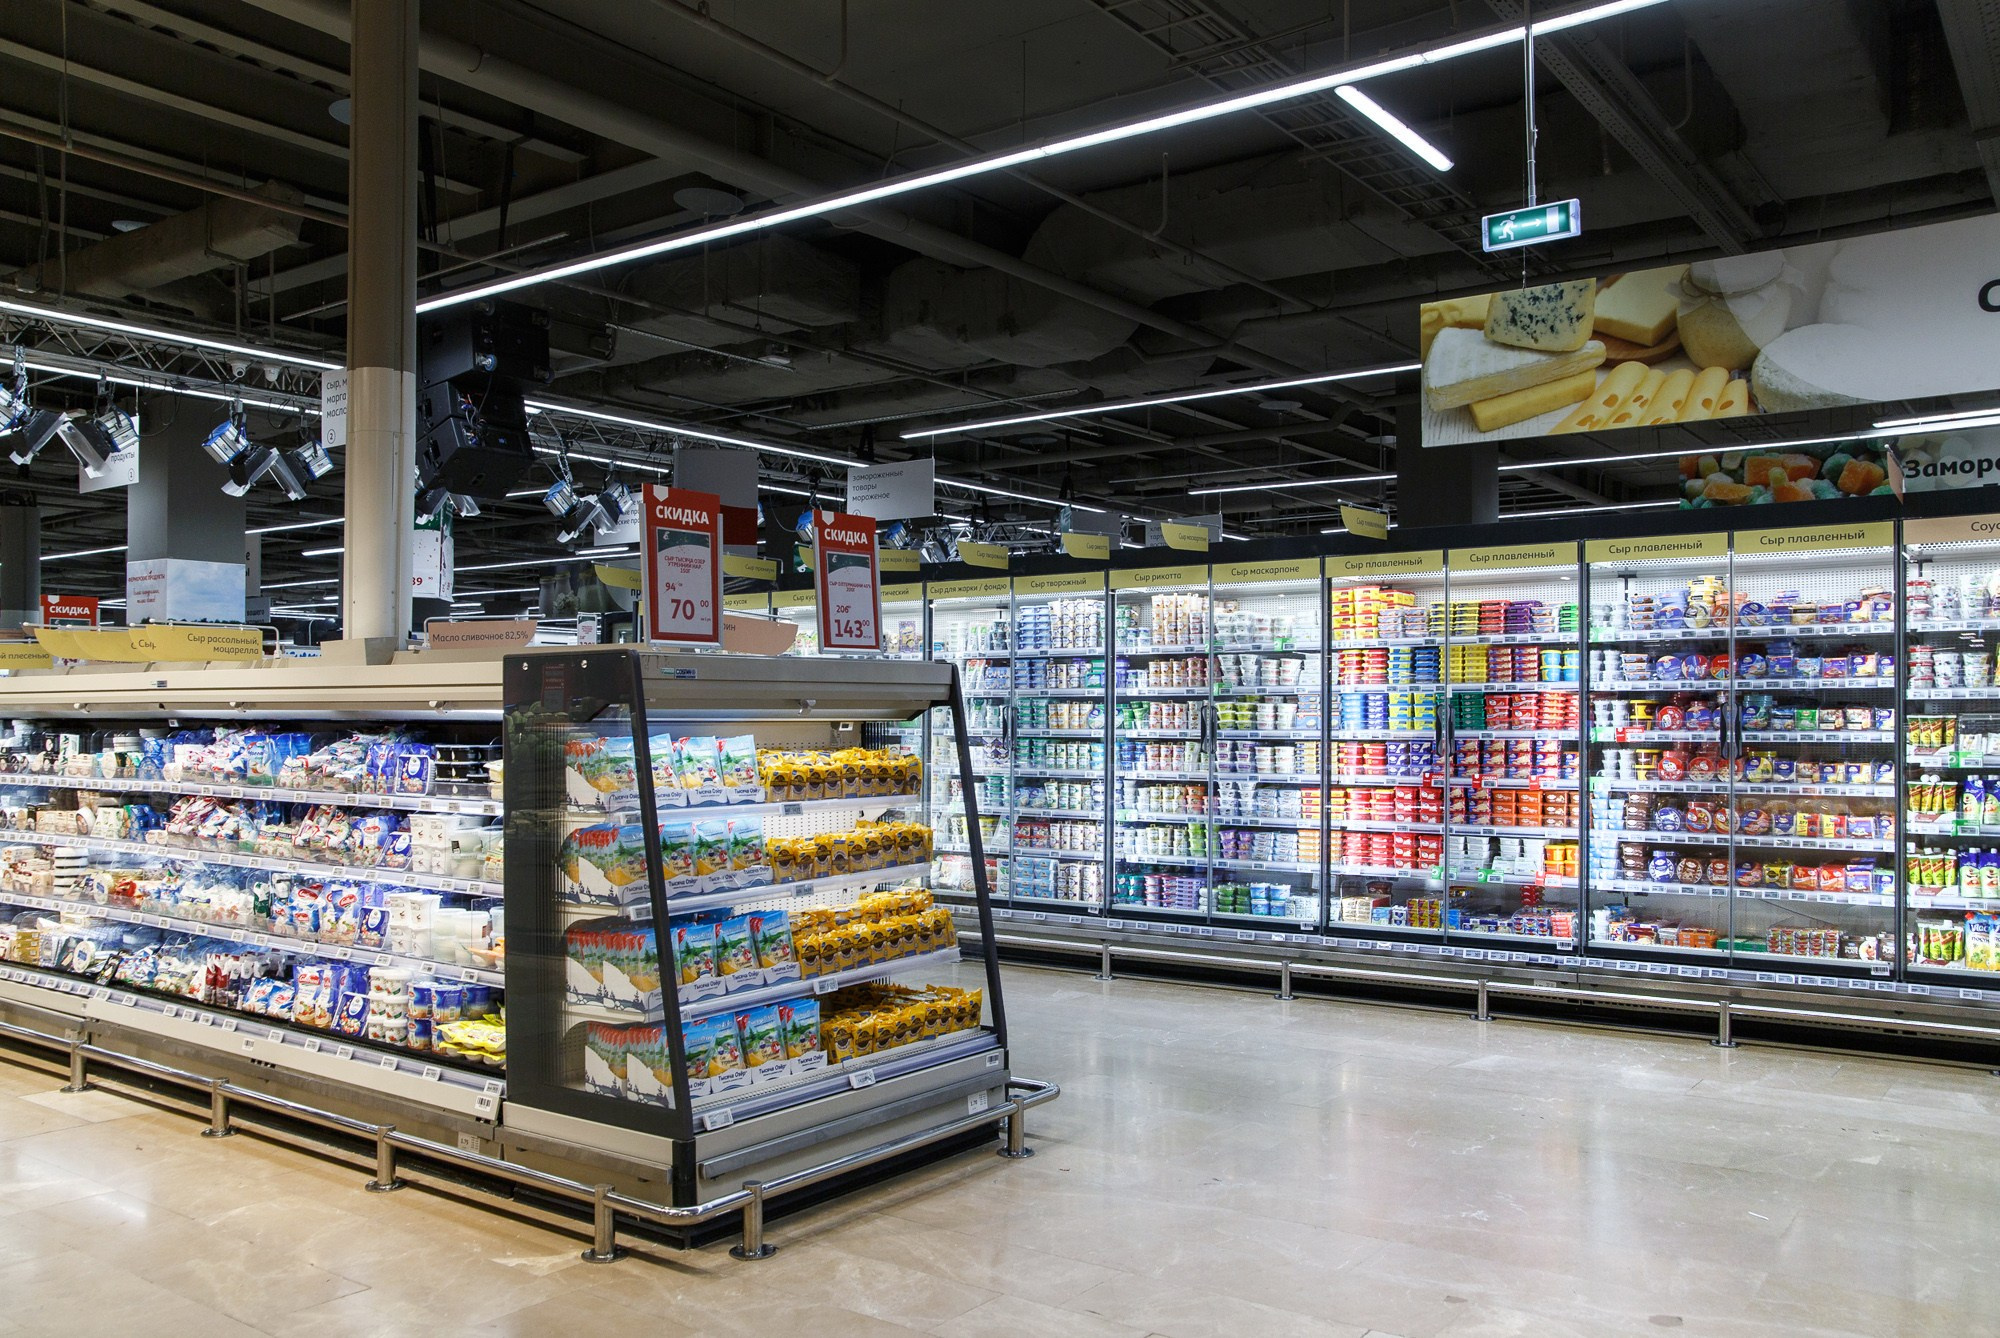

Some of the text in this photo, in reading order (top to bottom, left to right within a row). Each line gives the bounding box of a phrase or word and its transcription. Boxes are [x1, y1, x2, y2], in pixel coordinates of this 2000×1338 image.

[852, 470, 904, 482] замороженные
[852, 484, 877, 492] товары
[852, 493, 890, 503] мороженое
[655, 505, 710, 526] СКИДКА
[824, 528, 868, 546] СКИДКА
[1760, 529, 1865, 547] Сыр плавленный
[1608, 540, 1703, 555] Сыр плавленный
[1469, 549, 1555, 564] Сыр плавленный
[1231, 564, 1299, 577] Сыр маскарпоне
[1344, 556, 1423, 572] Сыр плавленный
[1030, 577, 1087, 589] Сыр творожный
[1134, 572, 1182, 583] Сыр рикотта
[665, 582, 676, 592] 94
[930, 582, 1007, 595] Сыр для жарки / фондю
[49, 605, 90, 616] СКИДКА
[670, 598, 709, 621] 70 00
[834, 619, 863, 639] 143
[187, 633, 259, 647] Сыр рассольный,
[432, 631, 529, 642] Масло сливочное 82,5%
[8, 652, 50, 660] плесенью
[213, 646, 259, 655] моцарелла
